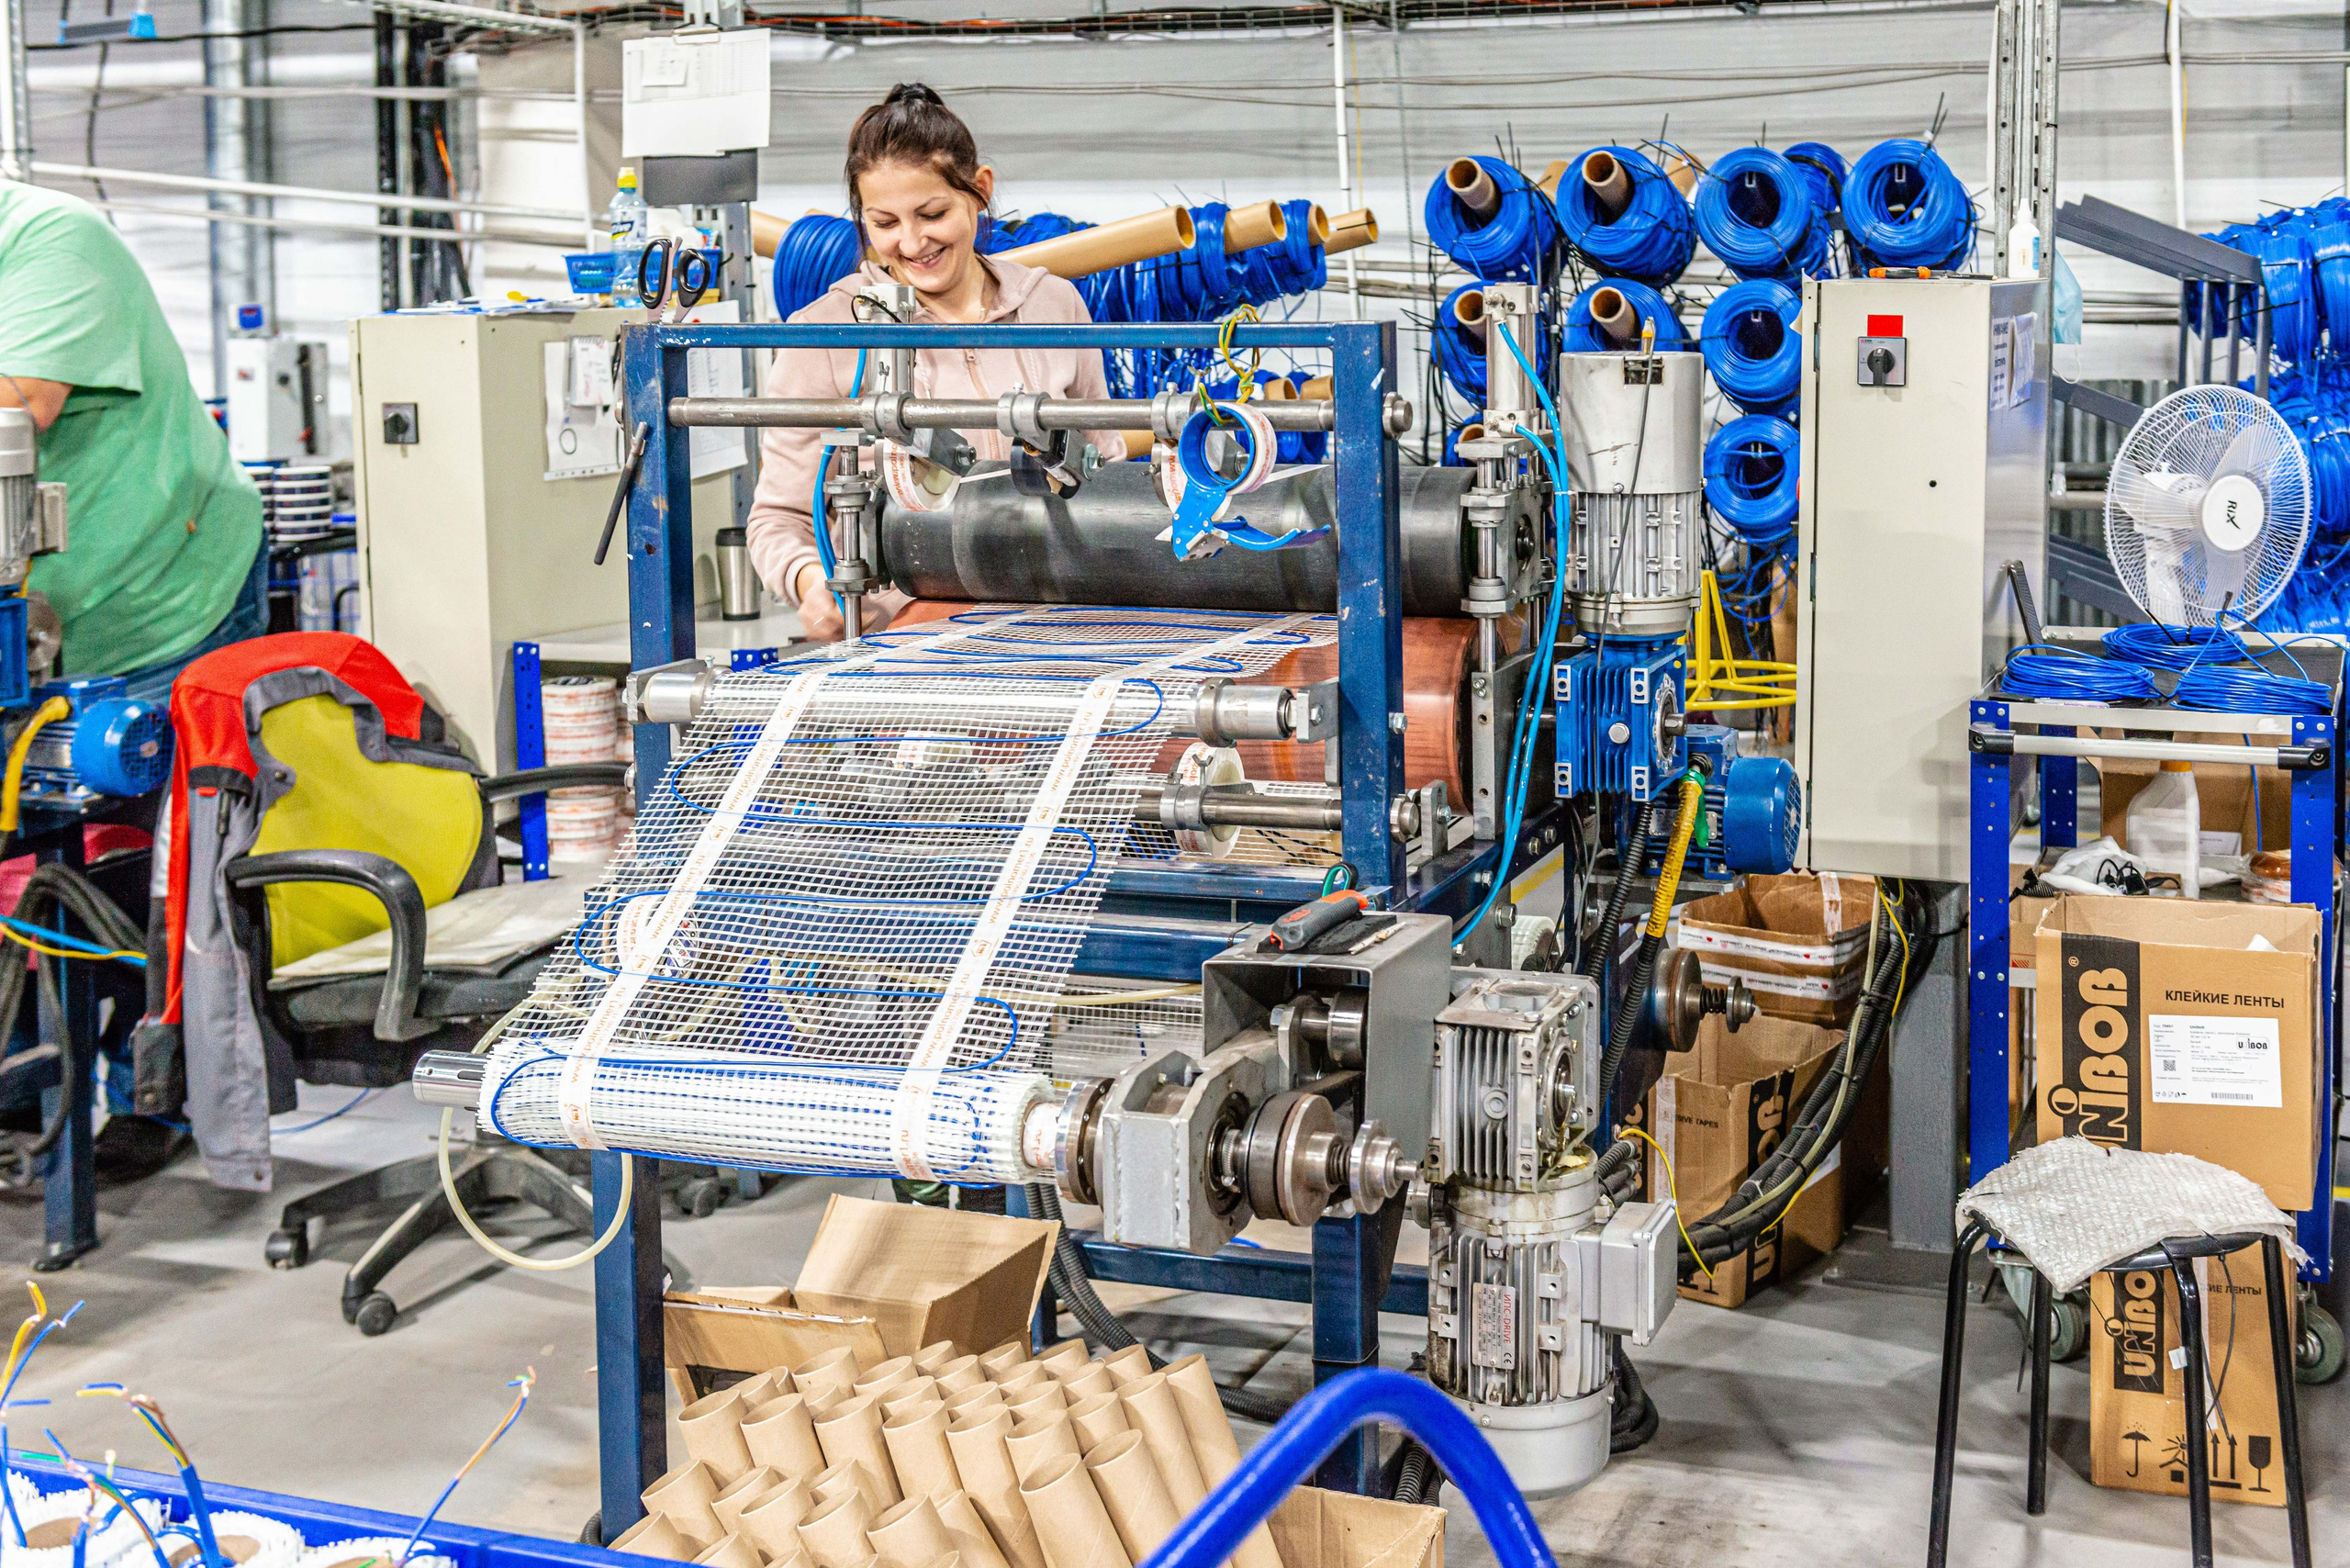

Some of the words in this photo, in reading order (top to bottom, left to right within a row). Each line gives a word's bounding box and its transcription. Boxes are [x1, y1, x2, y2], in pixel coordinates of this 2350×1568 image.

[2165, 990, 2230, 1005] КЛЕЙКИЕ
[2233, 995, 2285, 1009] ЛЕНТЫ
[1695, 1118, 1719, 1129] TAPES
